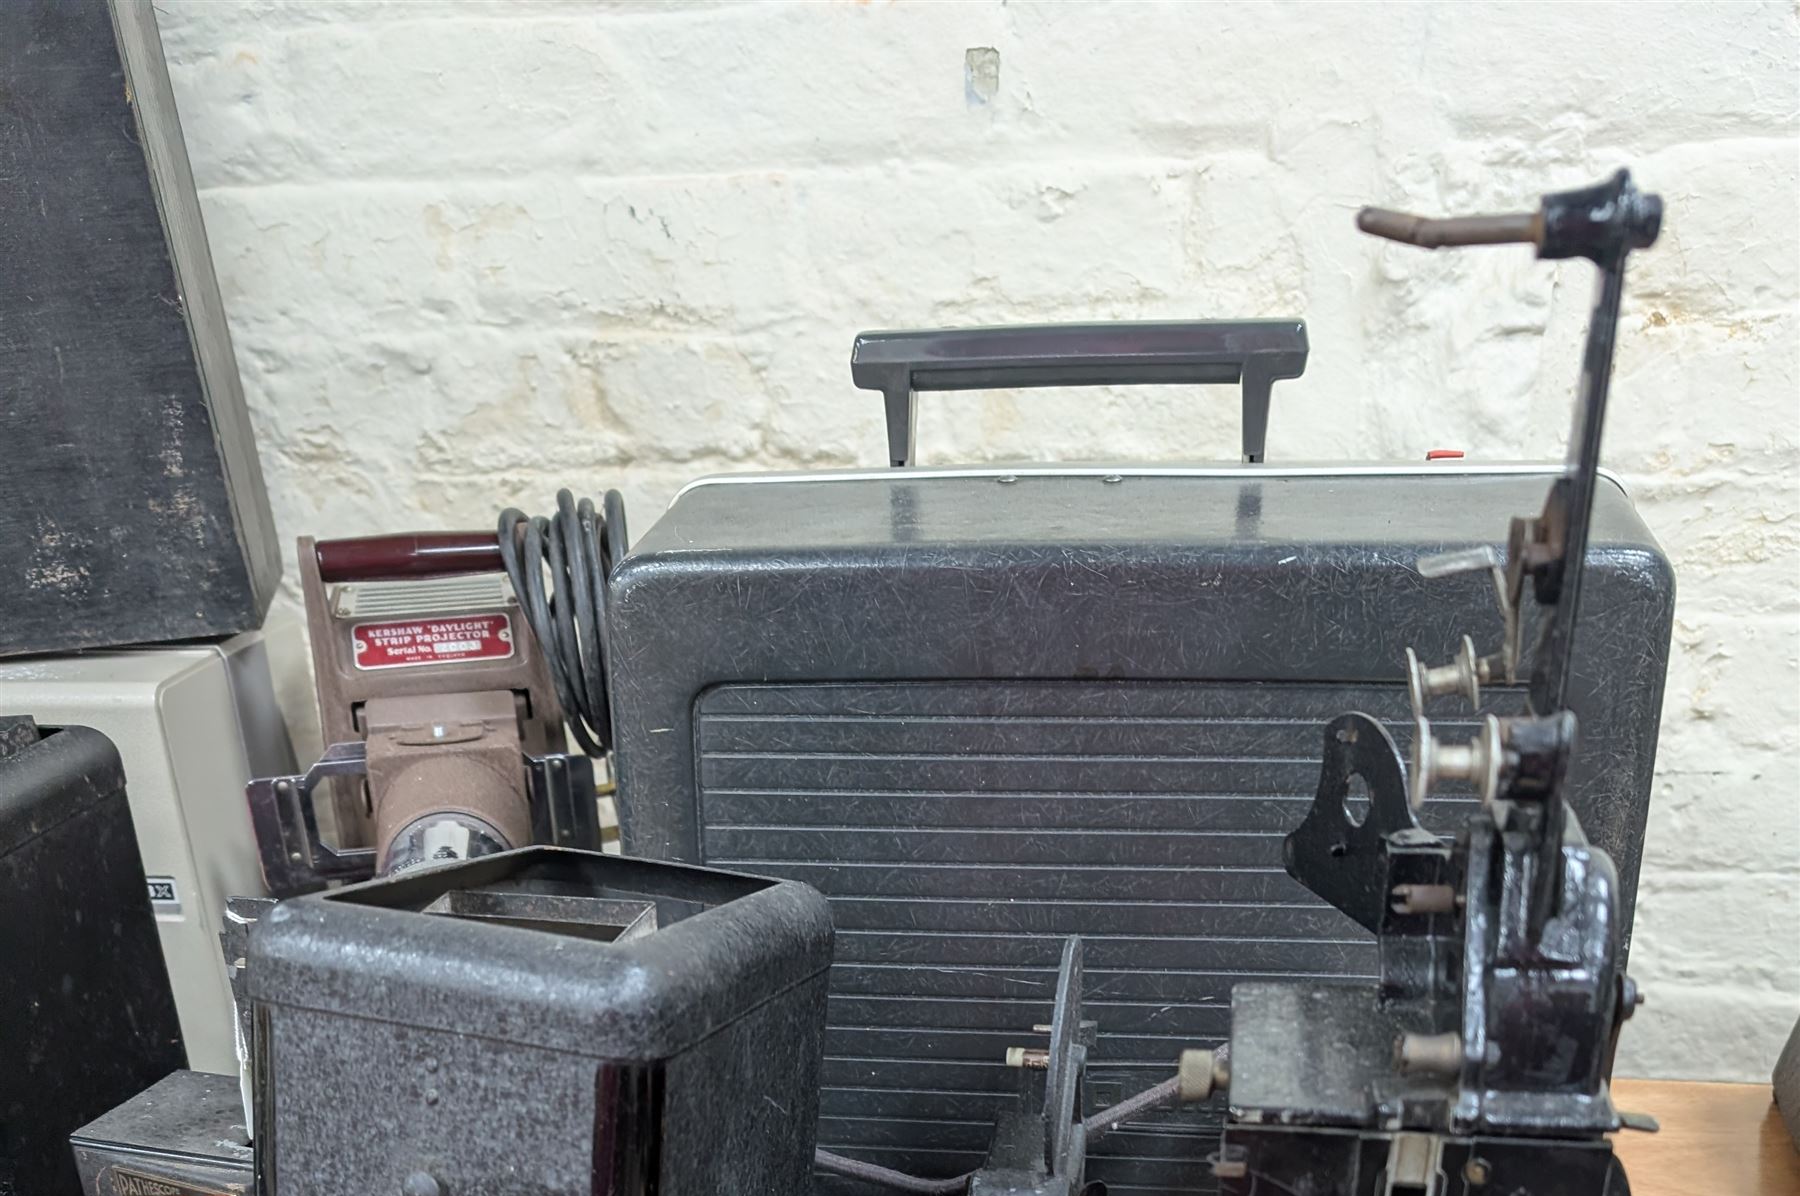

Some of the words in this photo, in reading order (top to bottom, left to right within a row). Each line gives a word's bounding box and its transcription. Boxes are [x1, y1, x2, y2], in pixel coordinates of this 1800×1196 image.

[368, 626, 423, 638] KERSHAW
[375, 636, 411, 646] STRIP
[416, 630, 490, 643] PROJECTOR
[387, 646, 416, 655] Serial
[118, 1174, 180, 1196] PATHESCOPE
